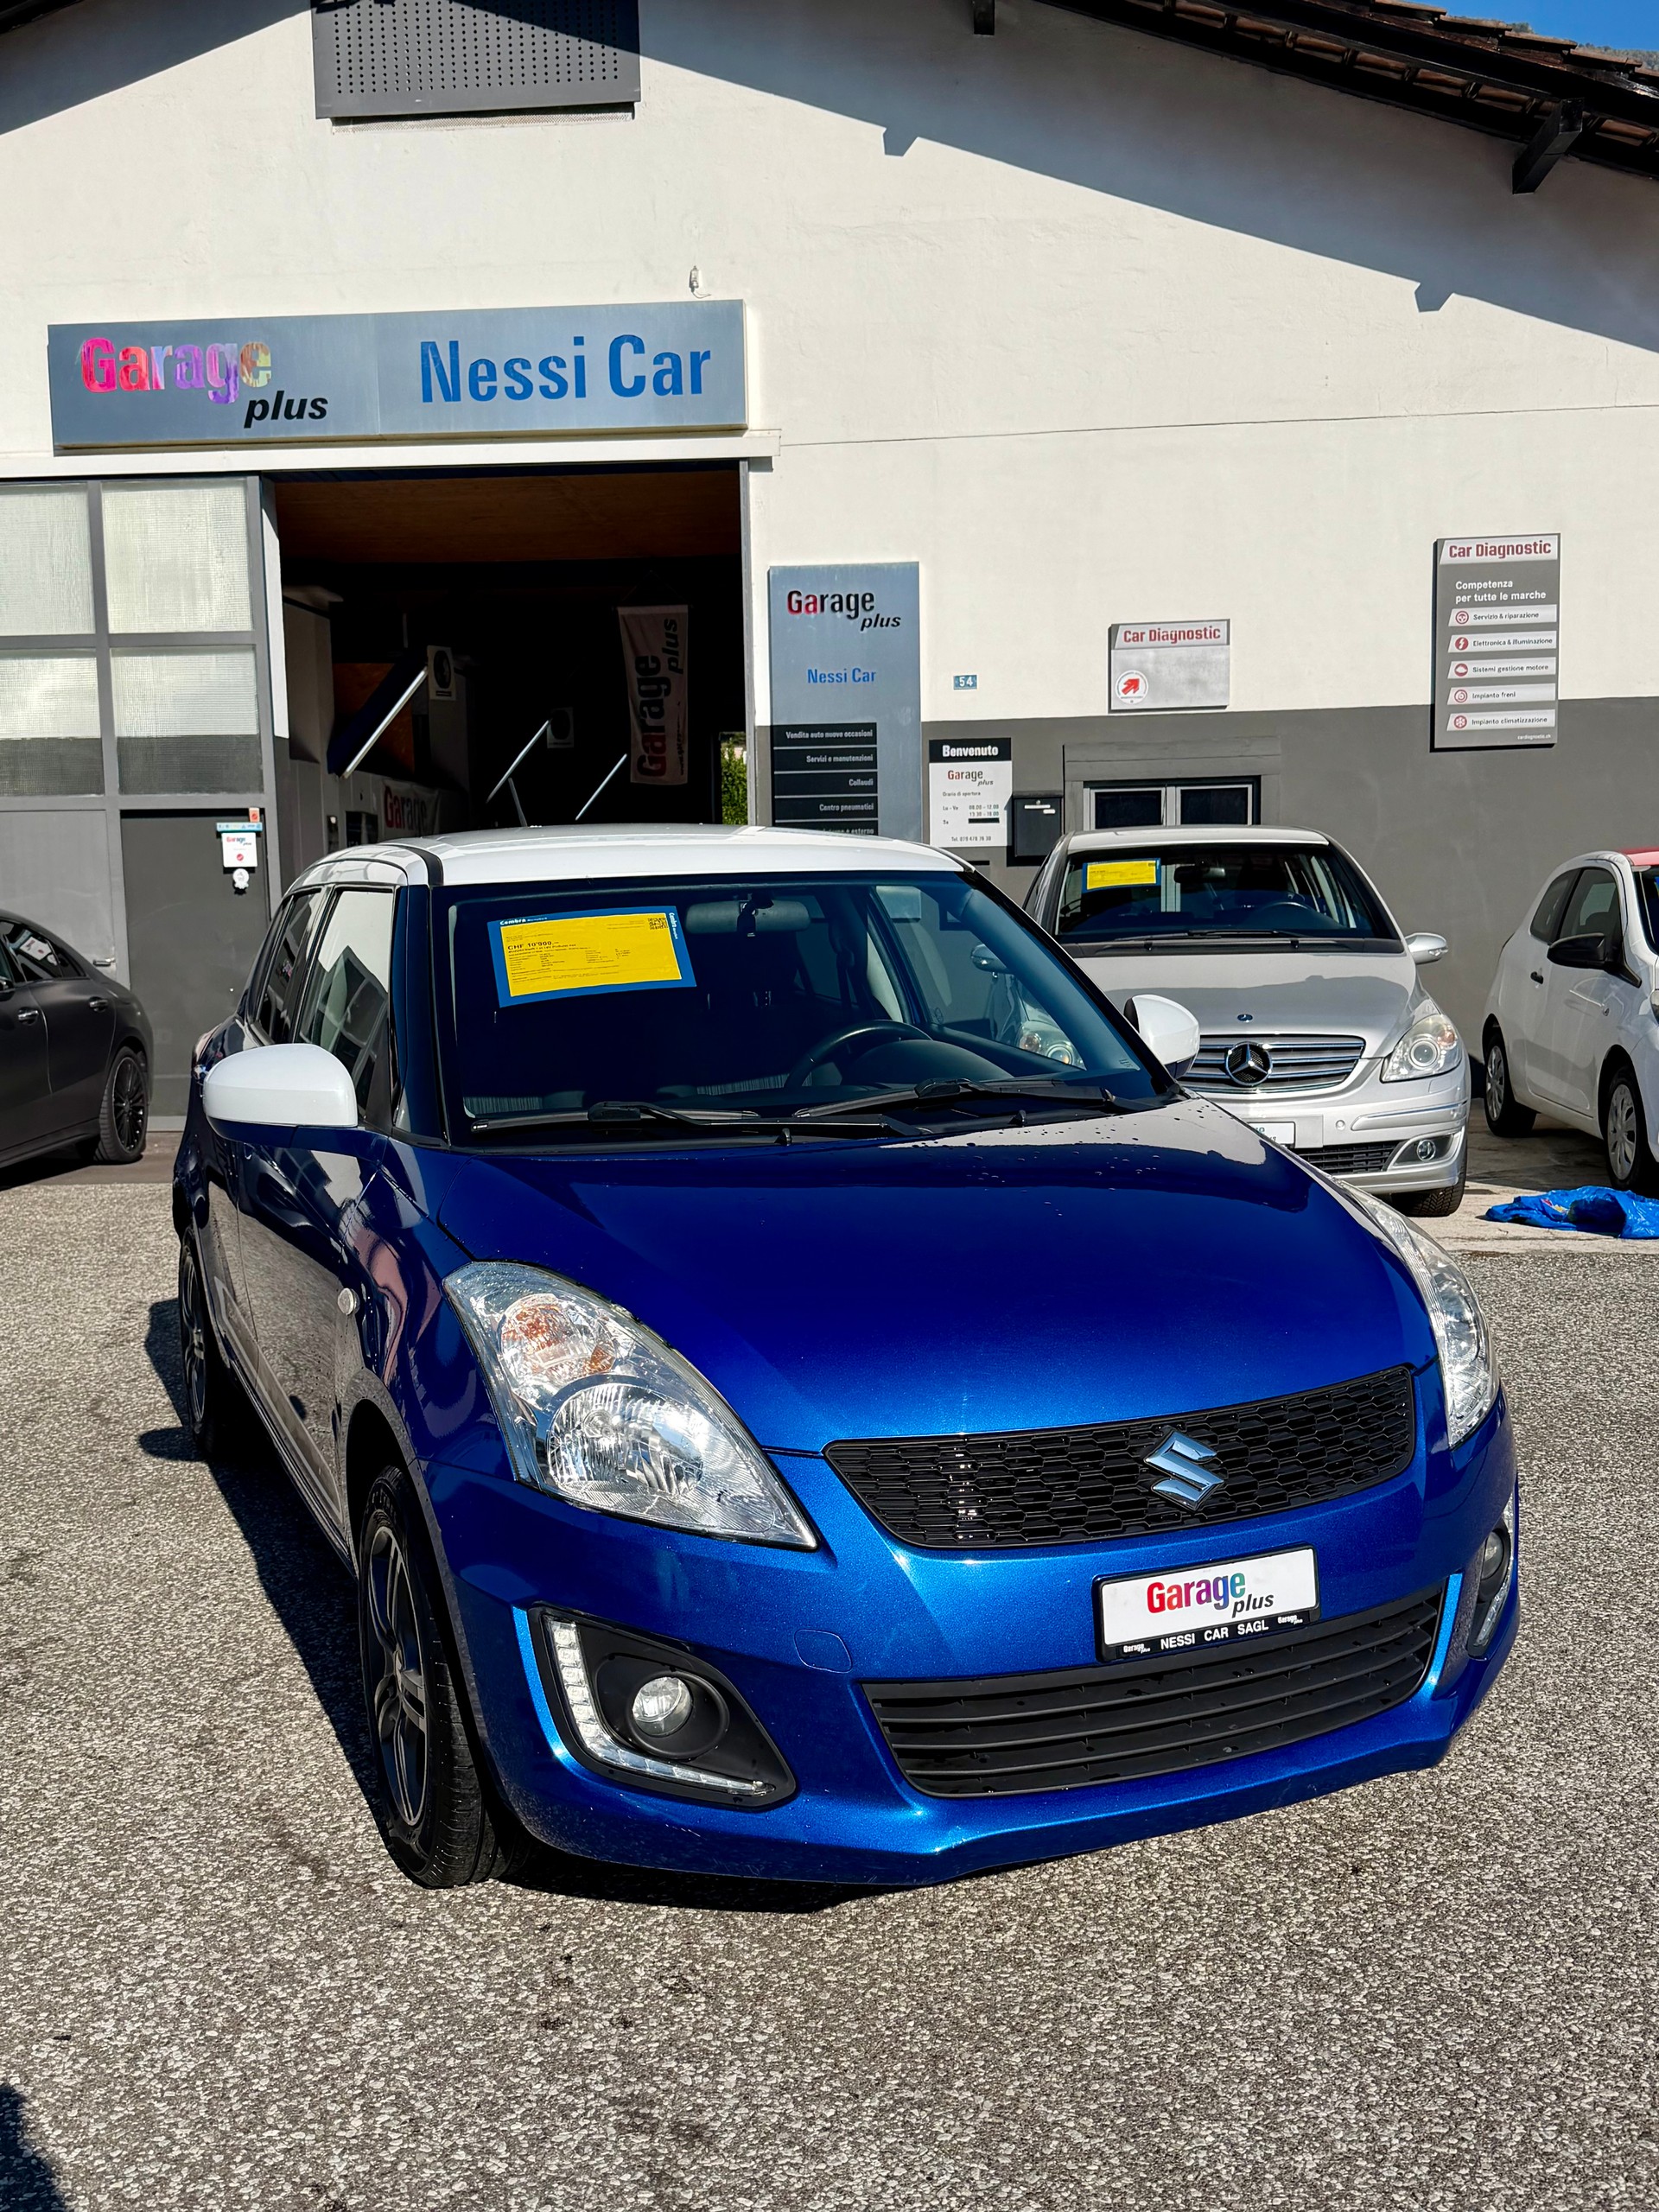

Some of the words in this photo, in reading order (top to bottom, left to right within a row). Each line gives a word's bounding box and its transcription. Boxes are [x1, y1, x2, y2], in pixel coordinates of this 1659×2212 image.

[80, 336, 272, 404] Garage
[420, 335, 587, 404] Nessi
[608, 334, 711, 397] Car
[244, 391, 328, 429] plus
[1449, 544, 1472, 558] Car
[1475, 540, 1552, 559] Diagnostic
[1455, 580, 1514, 591] Competenza
[787, 590, 875, 620] Garage
[1455, 594, 1471, 605] per
[1473, 593, 1497, 602] tutte
[1499, 592, 1509, 601] le
[1510, 590, 1547, 601] marche
[860, 613, 901, 632] plus
[1504, 612, 1539, 620] riparazione
[1123, 630, 1146, 643] Car
[1148, 626, 1221, 645] Diagnostic
[661, 619, 684, 675] plus
[807, 668, 848, 684] Nessi
[852, 667, 877, 683] Car
[1497, 664, 1524, 674] gestione
[959, 676, 974, 688] 54
[634, 655, 671, 777] Garage
[1500, 716, 1548, 725] climatizzazione
[785, 731, 810, 740] Vendita
[844, 729, 874, 738] occasioni
[832, 754, 874, 763] manutenzioni
[942, 745, 999, 758] Benvenuto
[849, 778, 874, 786] Collaudi
[947, 770, 983, 782] Garage
[840, 803, 874, 812] pneumatici
[1147, 1572, 1246, 1614] Garage
[1231, 1593, 1274, 1618] plus
[1277, 1614, 1298, 1624] Garage
[1160, 1633, 1196, 1649] NESSI
[1204, 1627, 1229, 1642] CAR
[1237, 1620, 1269, 1635] SAGL
[1123, 1643, 1145, 1654] Garage
